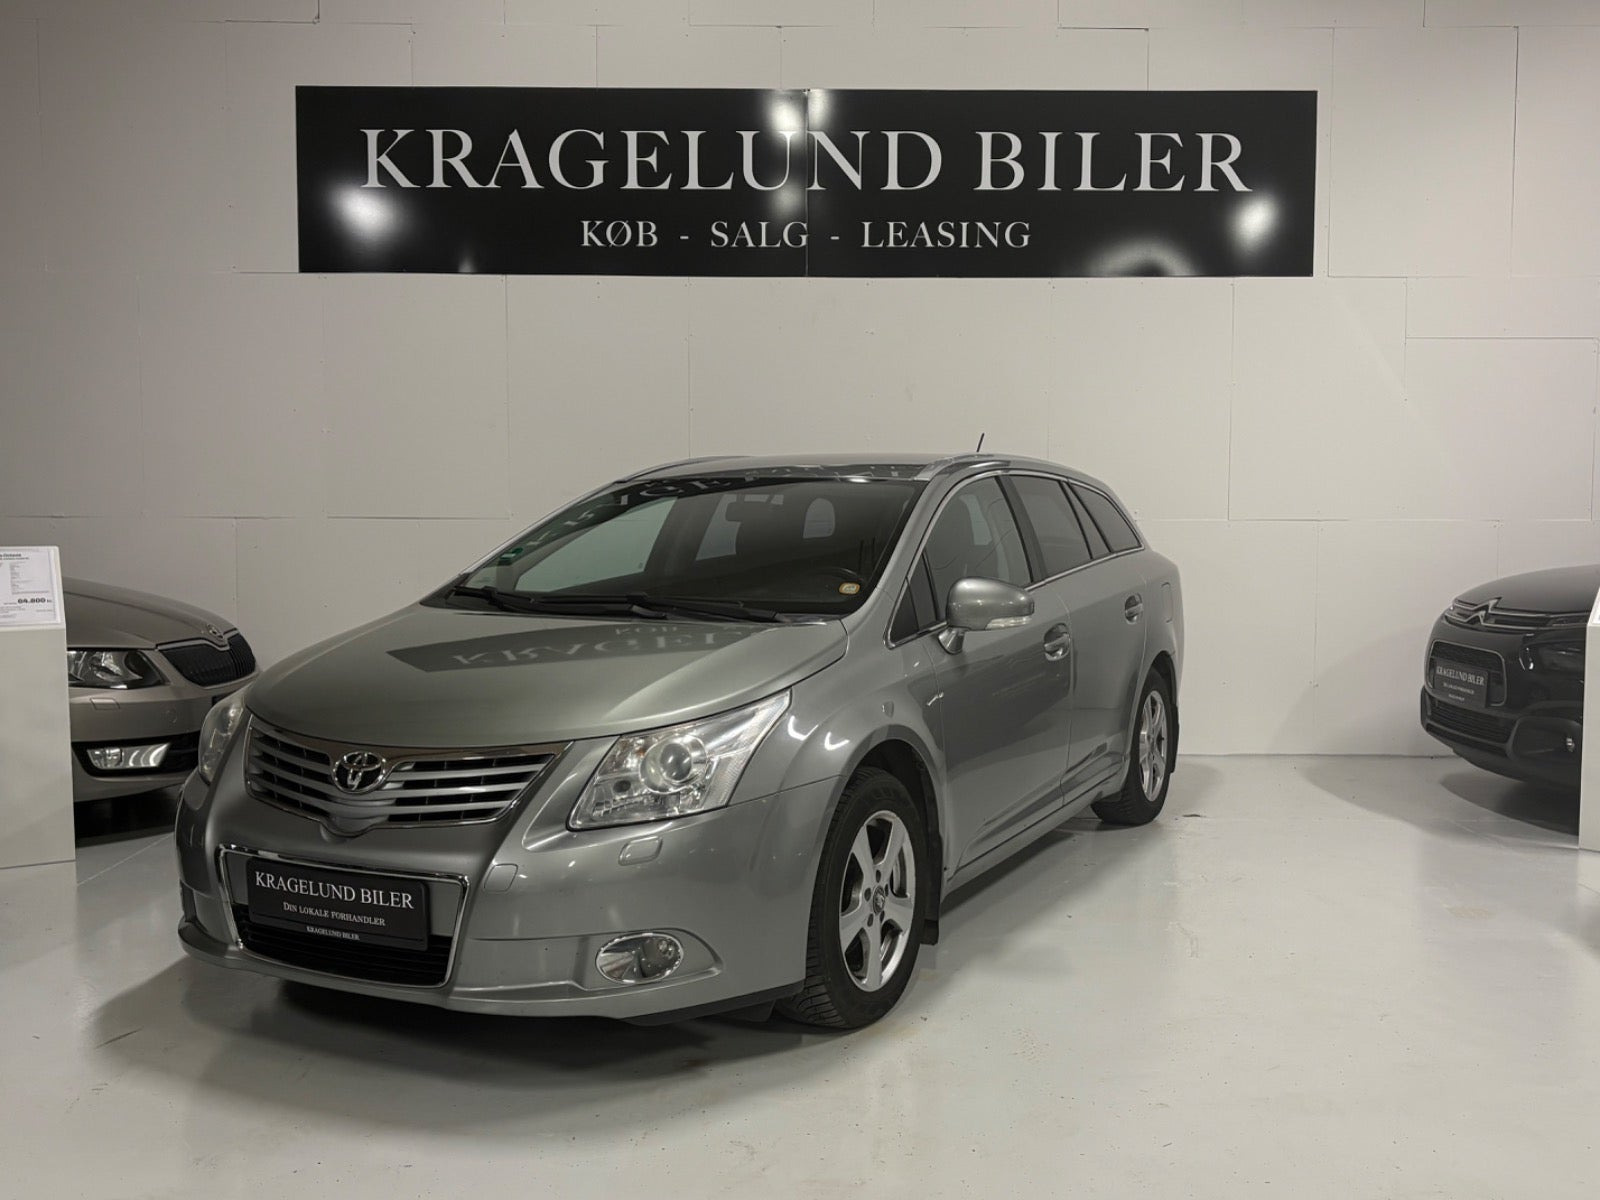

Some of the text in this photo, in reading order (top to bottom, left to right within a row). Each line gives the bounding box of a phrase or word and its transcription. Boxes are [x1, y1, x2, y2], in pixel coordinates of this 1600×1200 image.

[359, 128, 1253, 193] KRAGELUND BILER
[580, 219, 658, 248] KØB
[710, 220, 809, 249] SALG
[861, 220, 1032, 249] LEASING
[255, 871, 414, 909] KRAGELUND BILER
[299, 905, 329, 918] LOKALE
[331, 911, 386, 926] FORHANDLER
